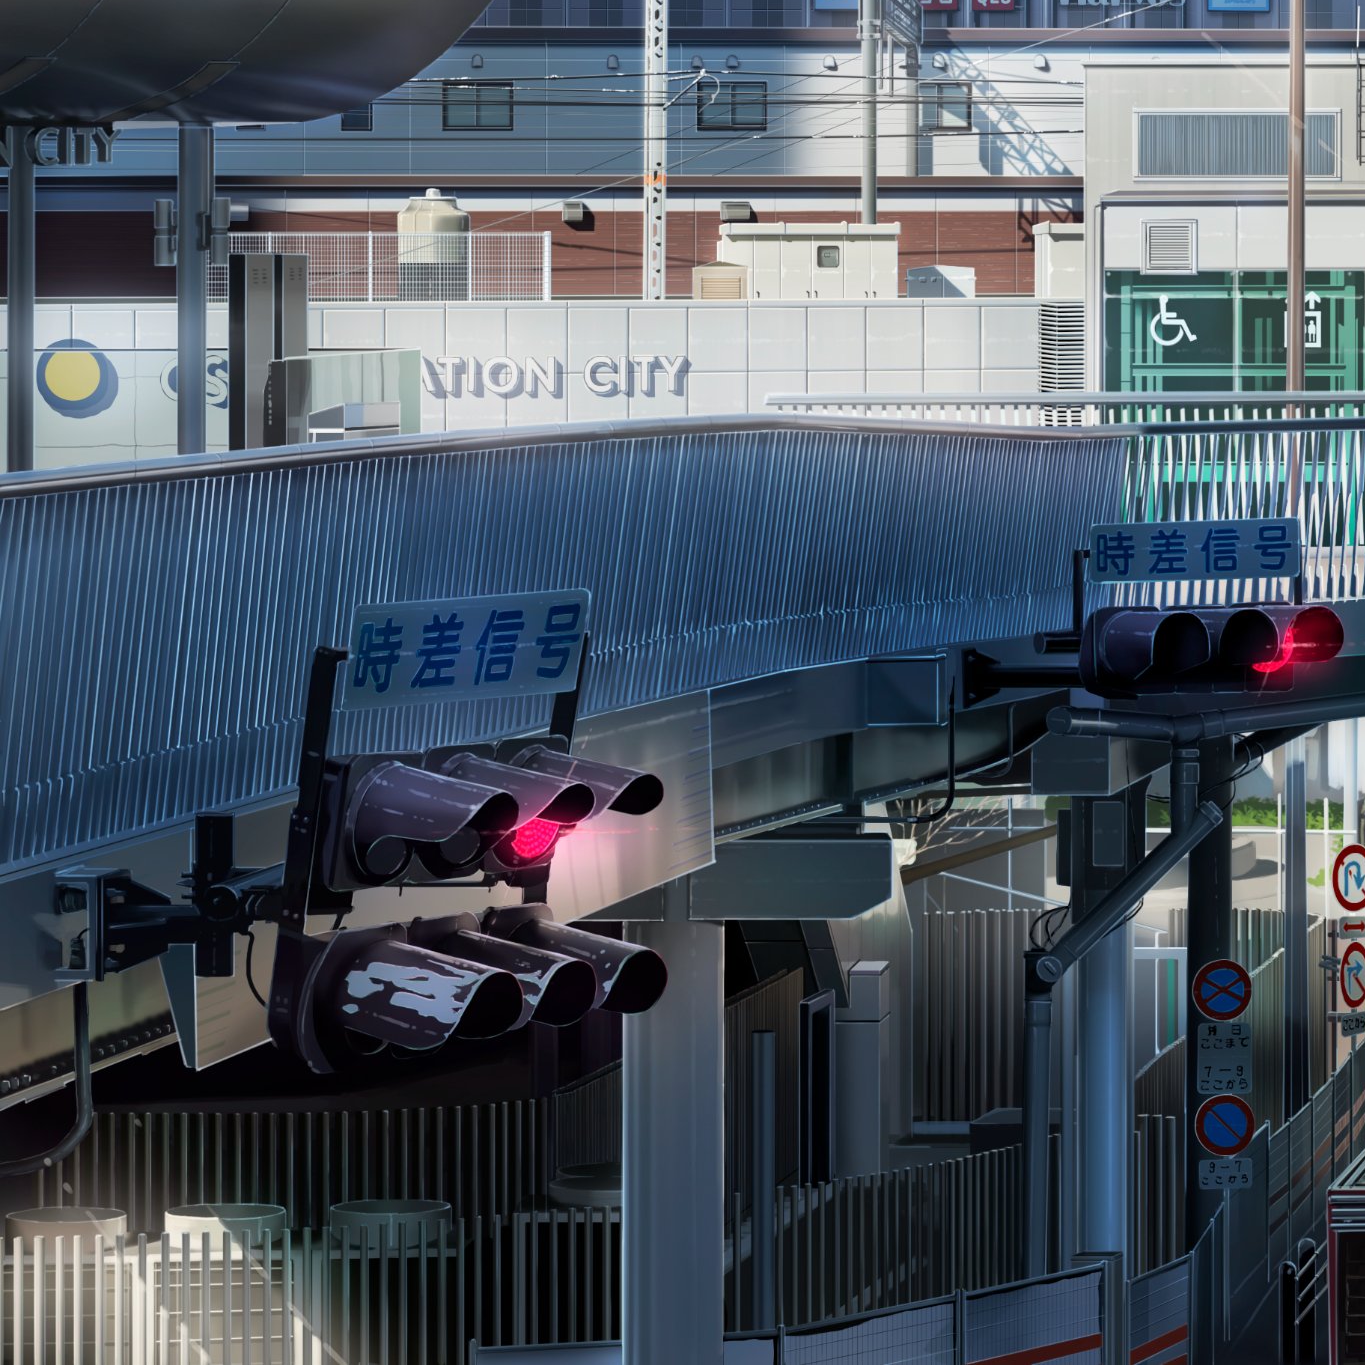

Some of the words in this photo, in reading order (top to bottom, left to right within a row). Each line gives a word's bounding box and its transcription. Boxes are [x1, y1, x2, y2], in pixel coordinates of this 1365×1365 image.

[583, 354, 687, 394] CITY
[1096, 525, 1293, 575] 時差信号
[353, 603, 581, 693] 時差信号
